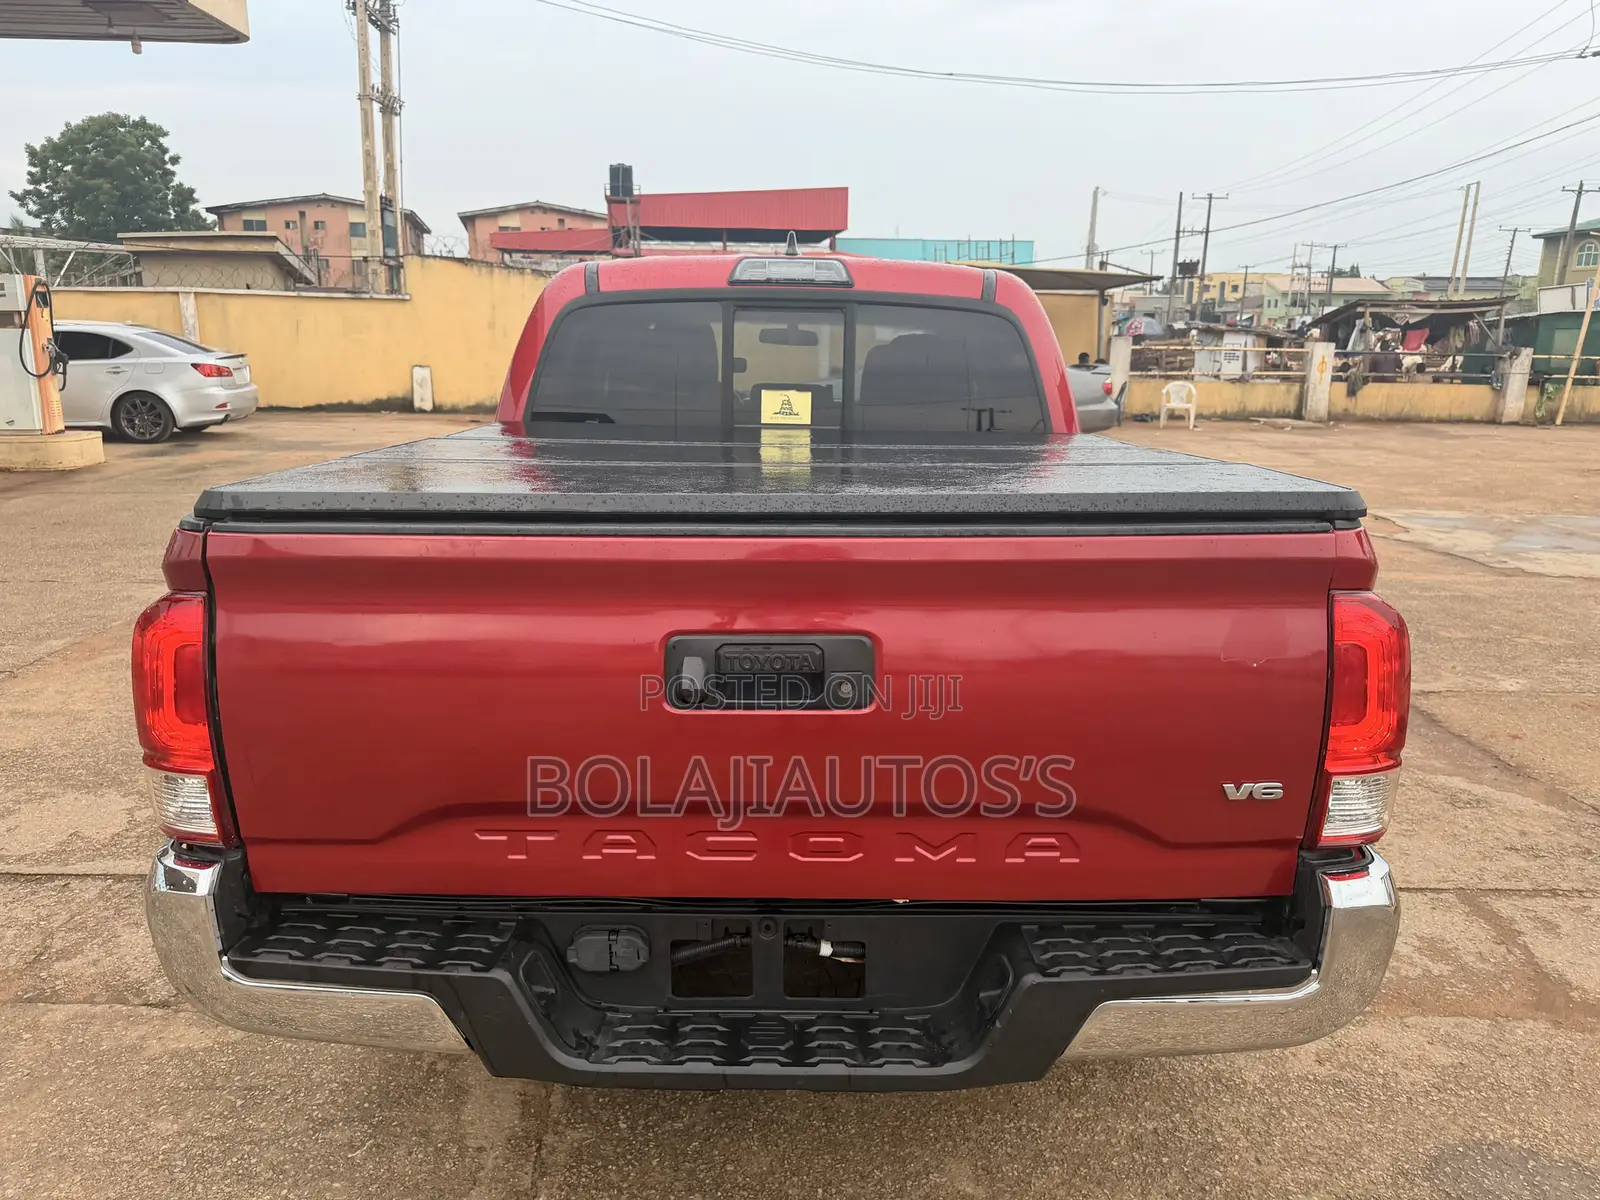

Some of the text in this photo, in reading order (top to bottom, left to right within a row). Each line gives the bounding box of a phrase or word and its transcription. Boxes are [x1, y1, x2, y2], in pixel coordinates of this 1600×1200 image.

[725, 653, 818, 672] TOYOTA
[1222, 782, 1284, 800] V6
[474, 830, 1081, 862] TACOMA
